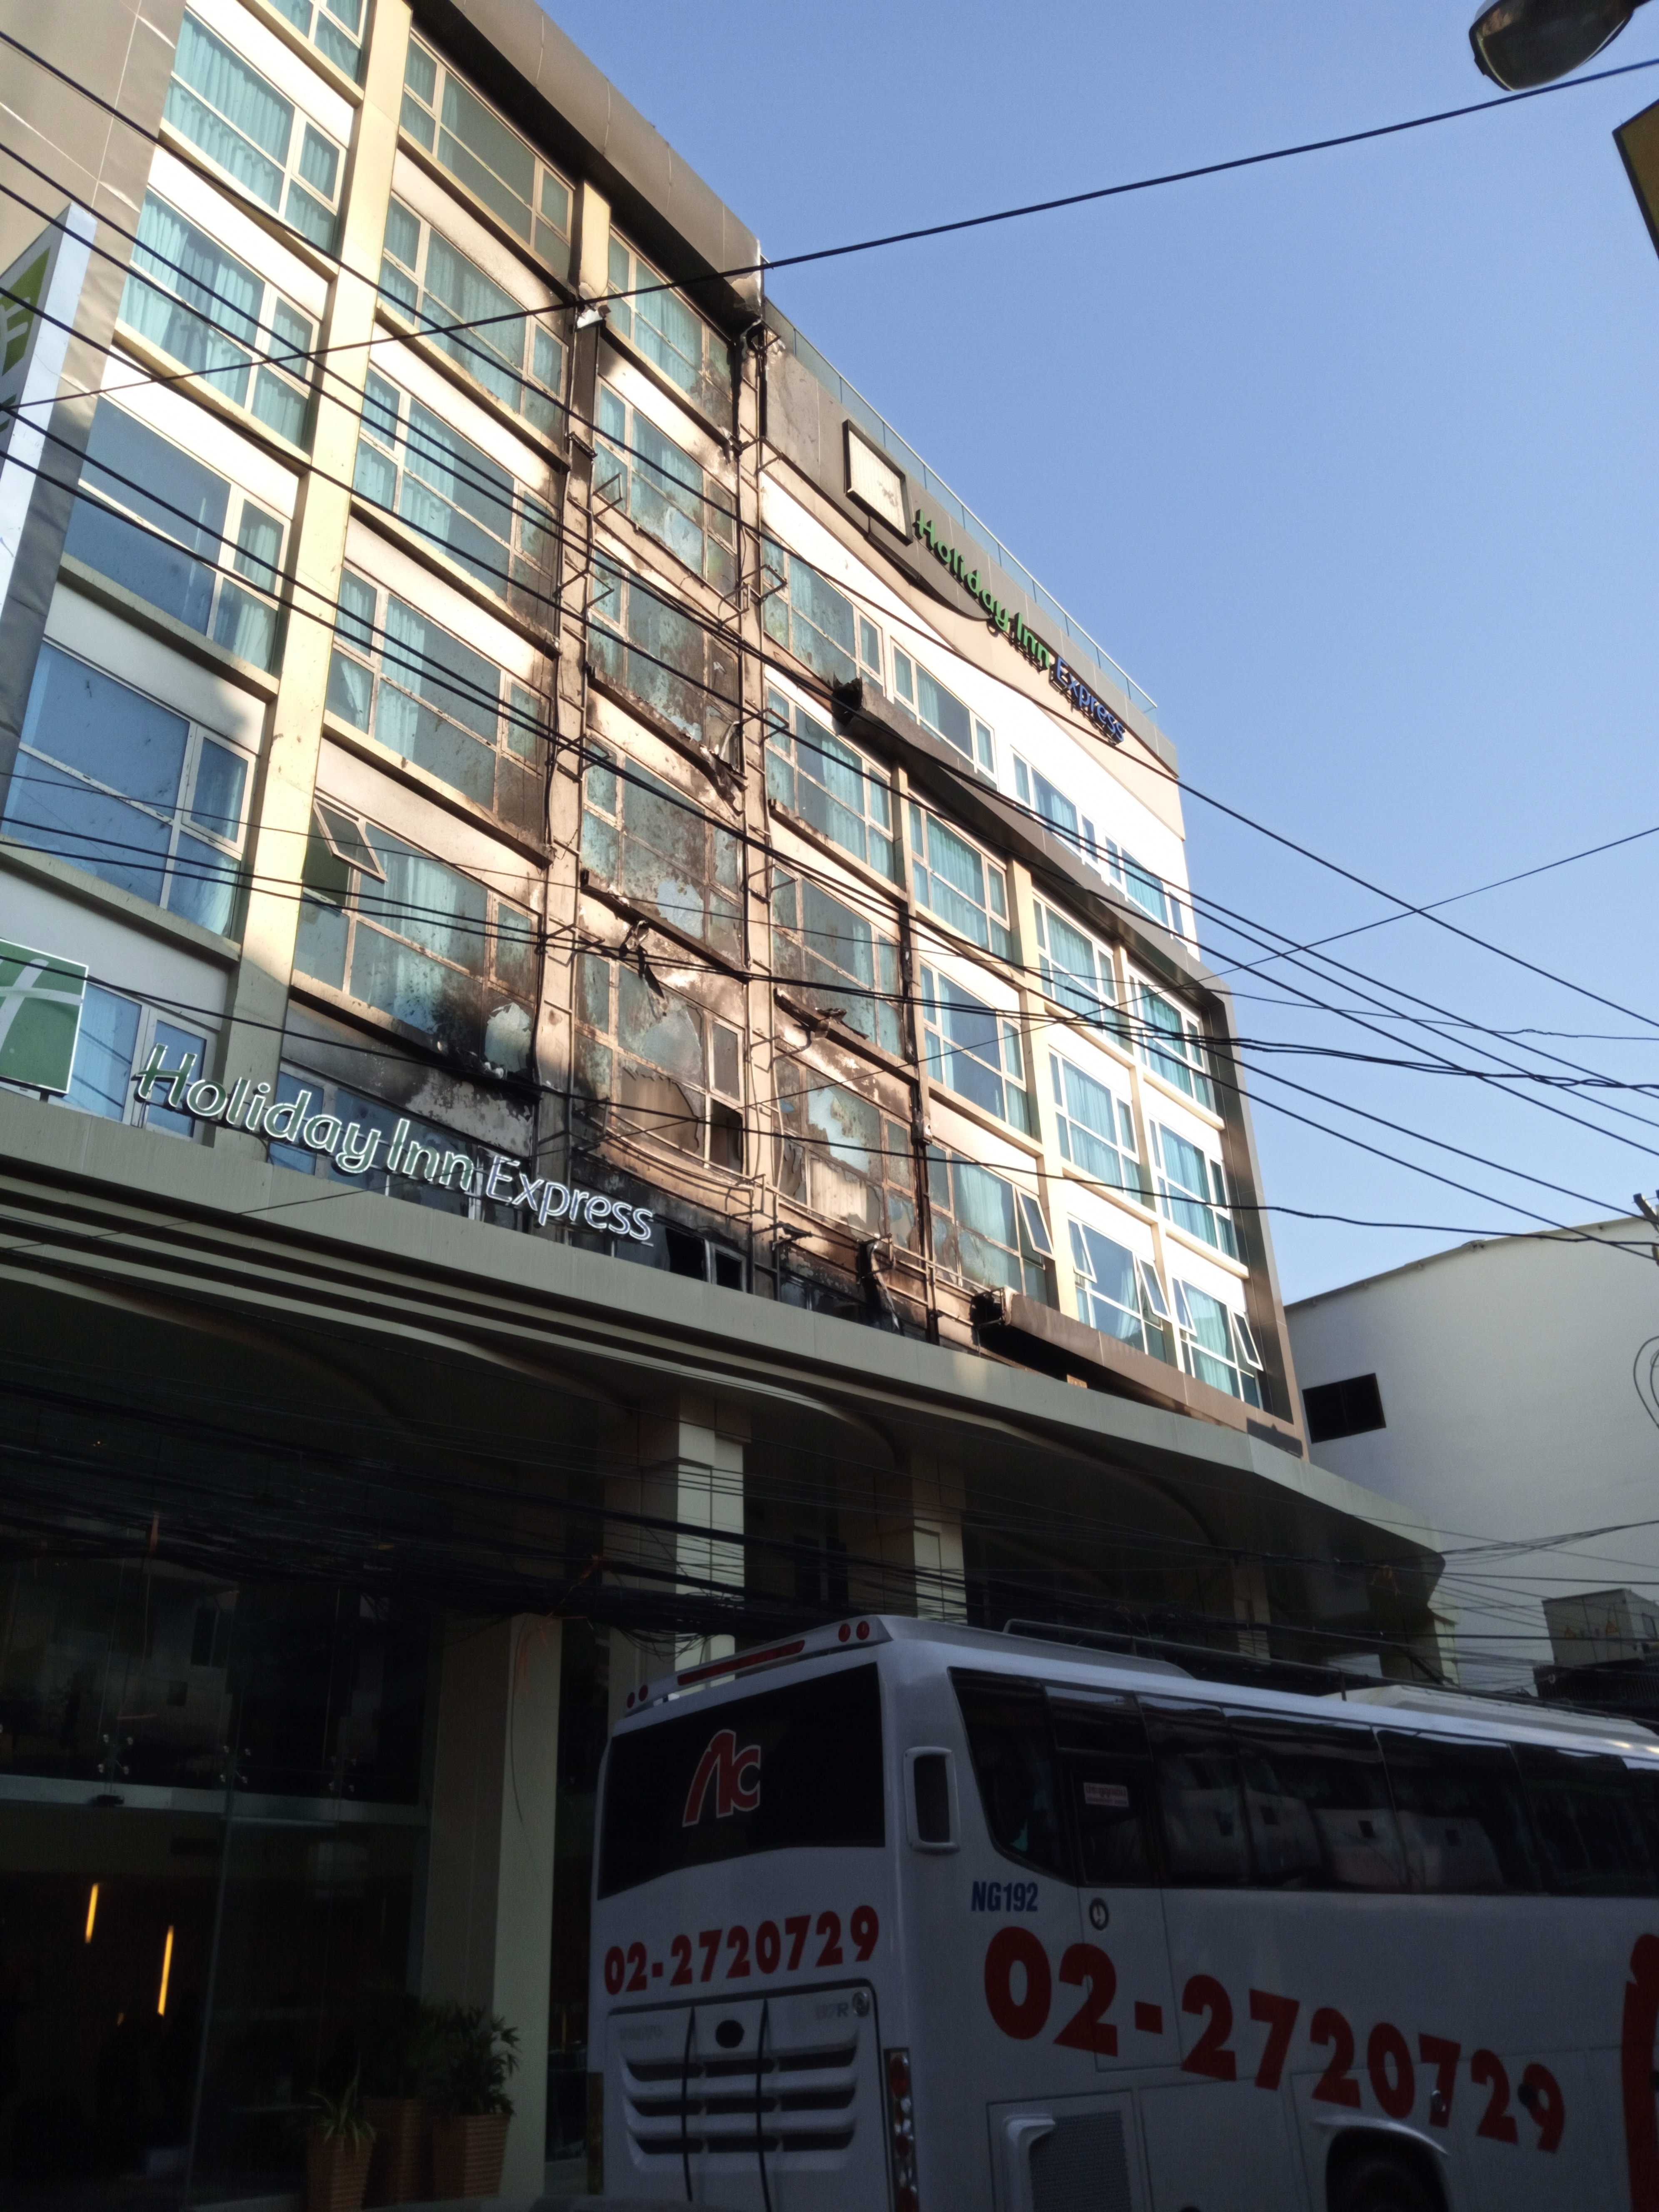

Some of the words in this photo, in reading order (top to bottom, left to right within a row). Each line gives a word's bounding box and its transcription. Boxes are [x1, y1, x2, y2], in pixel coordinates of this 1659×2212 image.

[916, 509, 1009, 632] Holiday
[1016, 613, 1050, 669] Inn
[1056, 656, 1125, 742] Express
[133, 1043, 382, 1174] Holiday
[387, 1118, 474, 1191] Inn
[486, 1155, 653, 1241] Express
[605, 1905, 879, 1995] 02-2720729
[971, 1881, 1038, 1911] NG192
[984, 1926, 1564, 2154] 02-2720729
